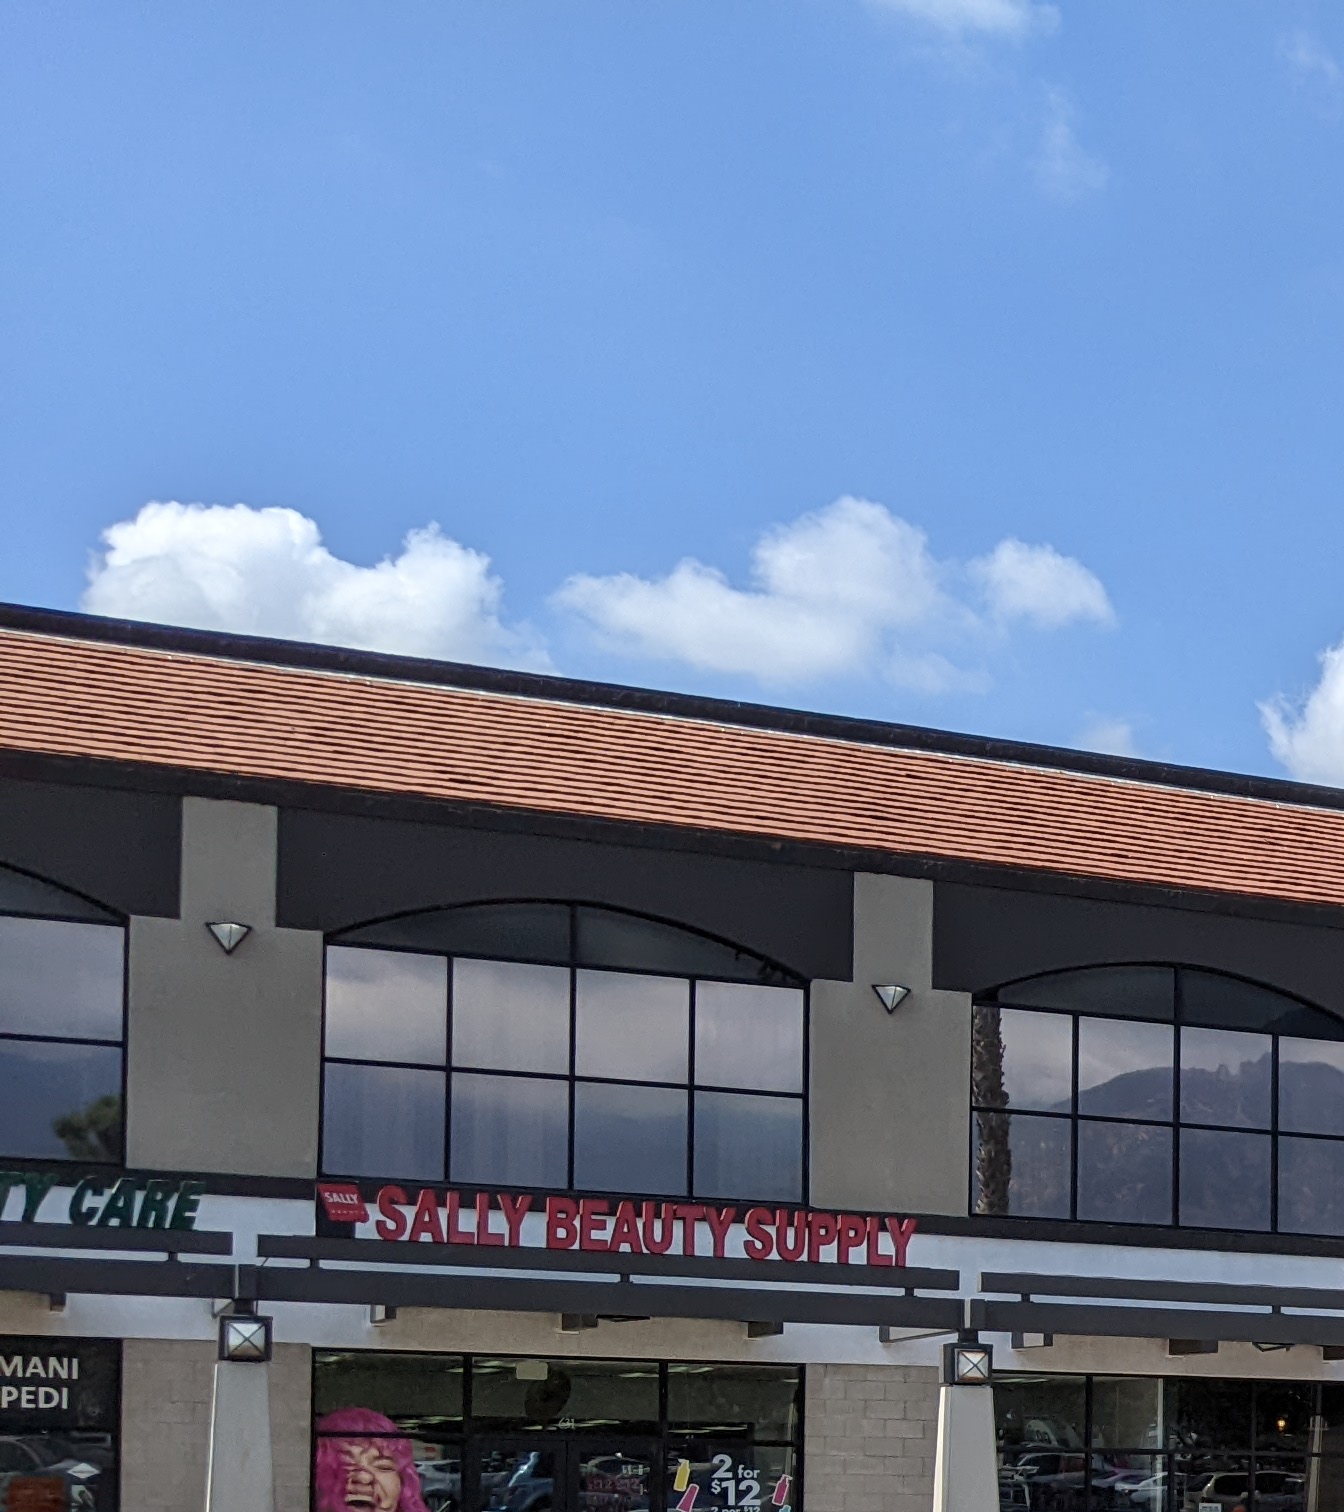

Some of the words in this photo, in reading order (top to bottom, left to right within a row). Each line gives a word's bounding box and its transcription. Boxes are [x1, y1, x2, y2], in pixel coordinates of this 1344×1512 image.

[69, 1175, 206, 1230] CARE
[324, 1191, 358, 1206] SALLY
[375, 1184, 532, 1248] SALLY
[546, 1196, 737, 1259] BEAUTY
[743, 1206, 918, 1268] SUPPLY
[0, 1356, 79, 1380] MANI
[0, 1386, 69, 1410] PEDI
[711, 1454, 733, 1479] 2
[737, 1464, 761, 1479] for
[711, 1479, 762, 1506] $12
